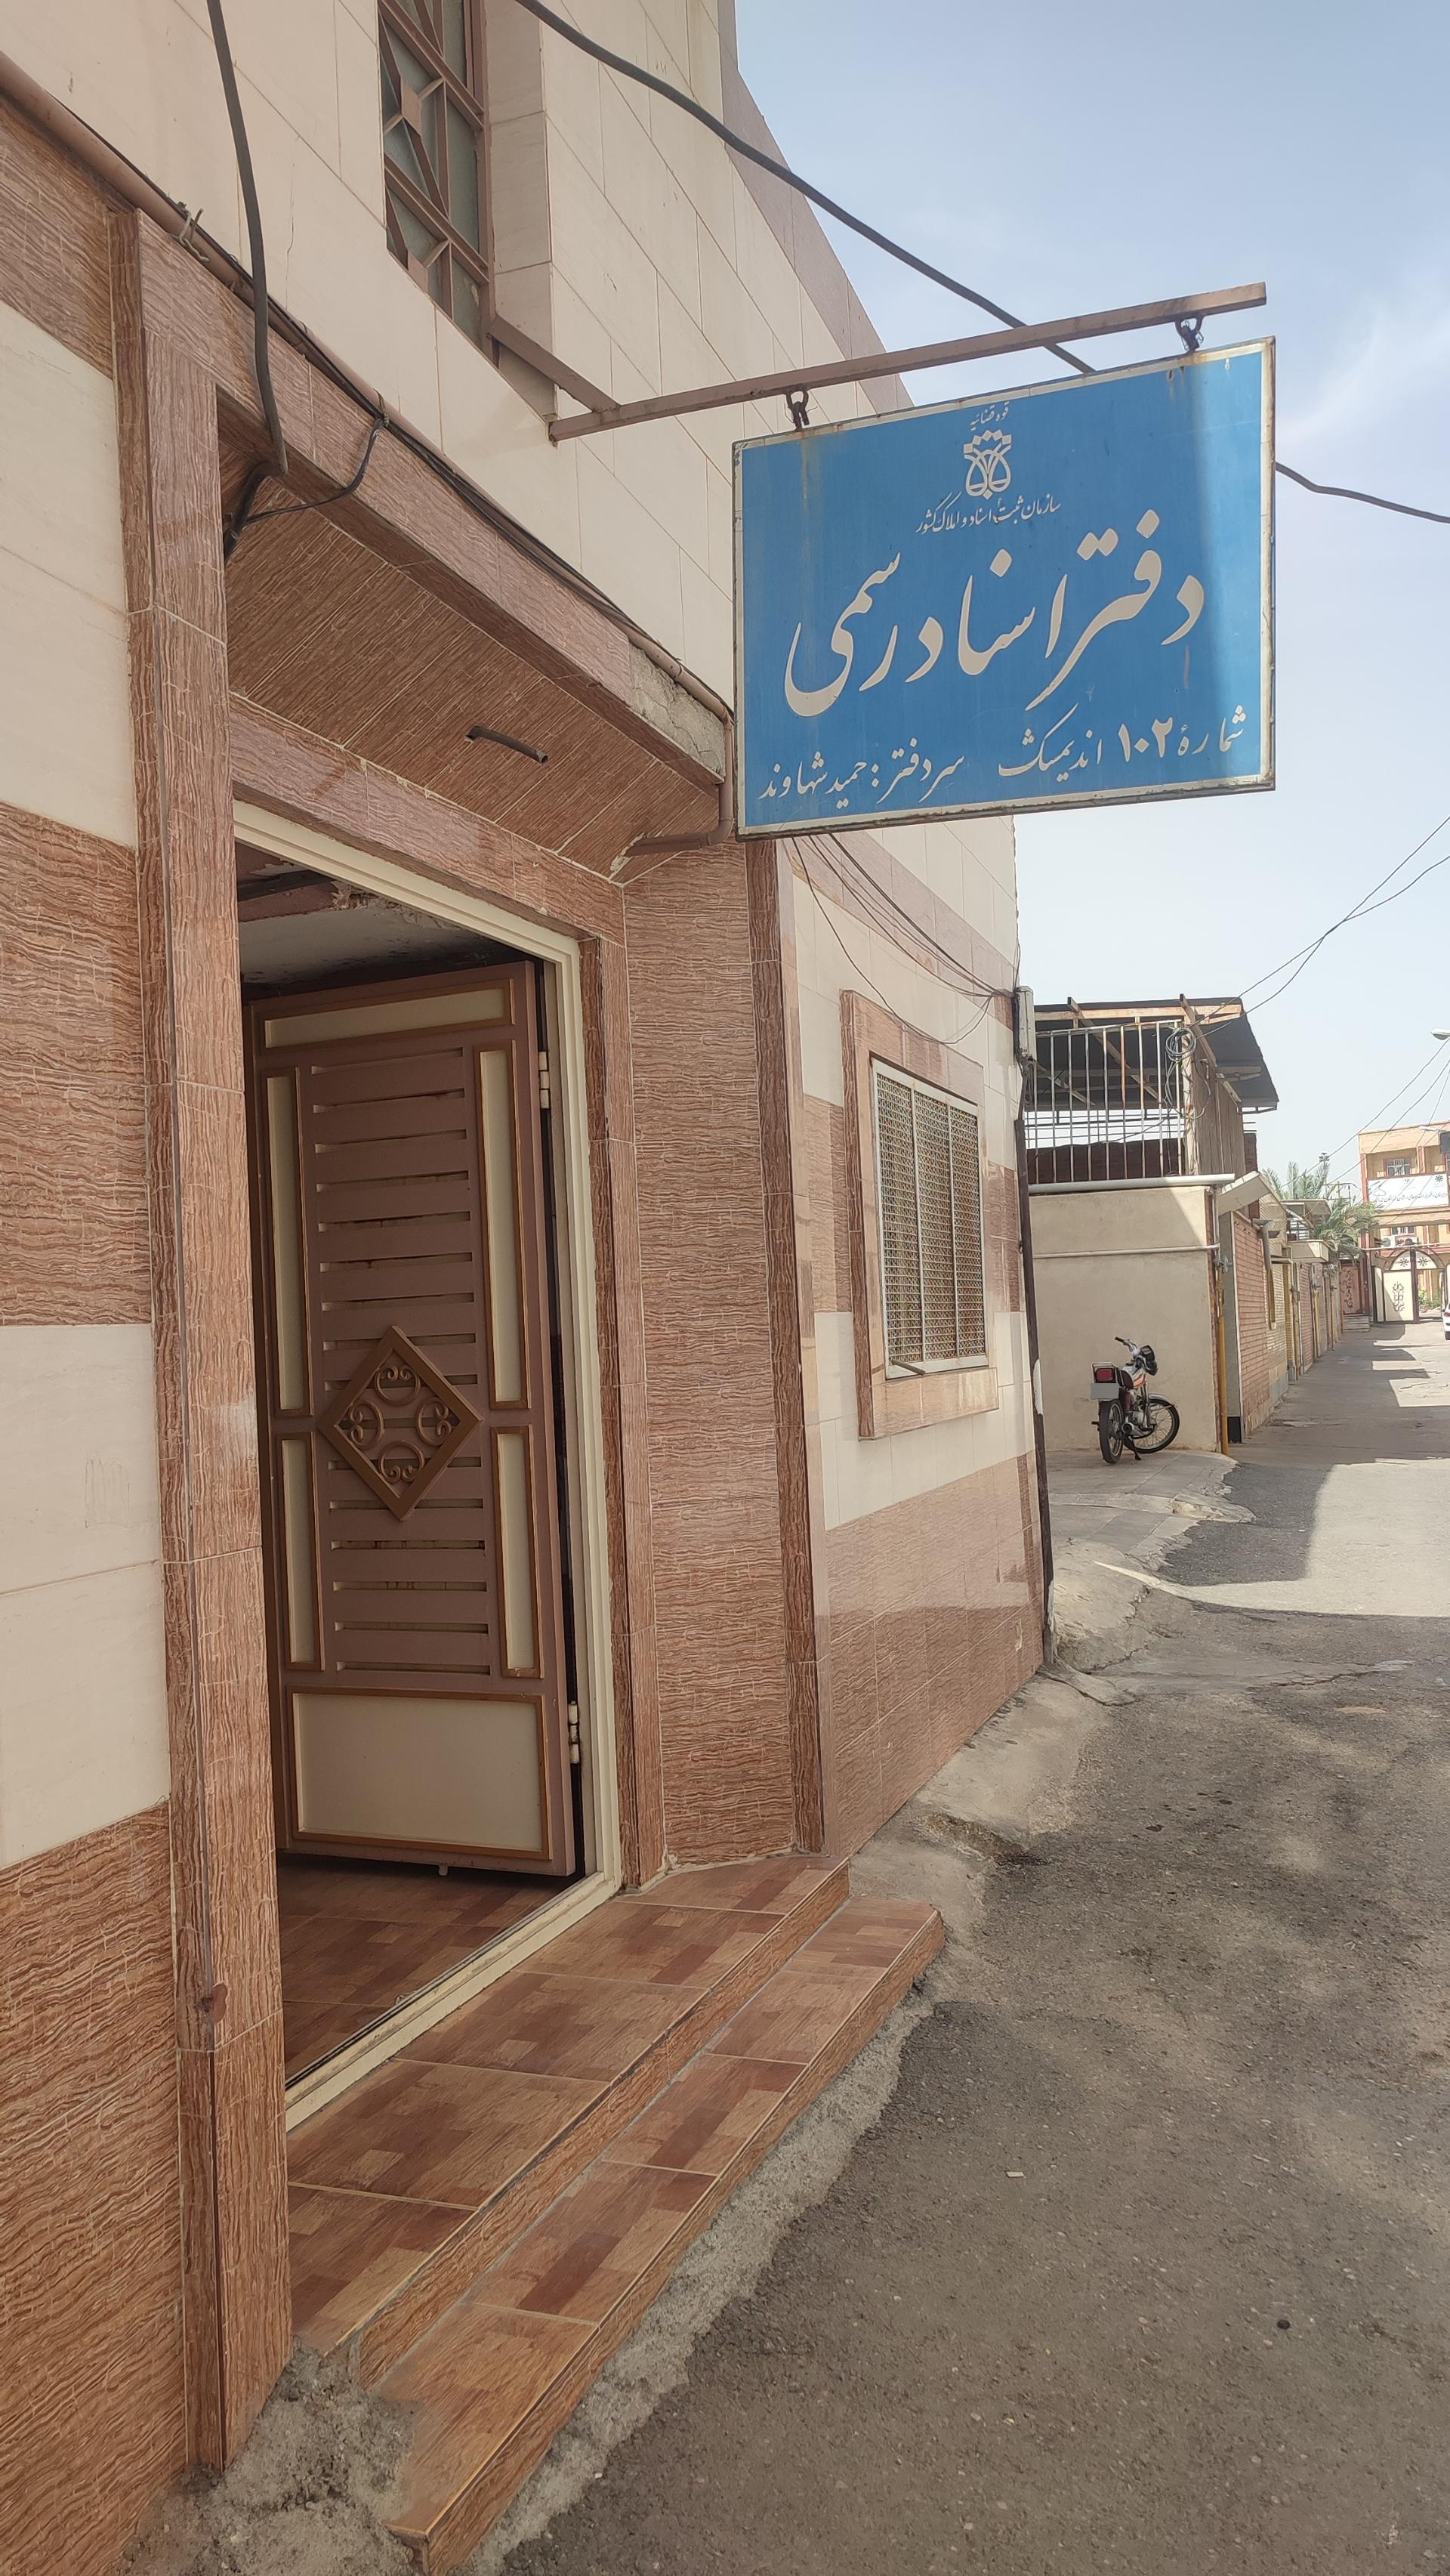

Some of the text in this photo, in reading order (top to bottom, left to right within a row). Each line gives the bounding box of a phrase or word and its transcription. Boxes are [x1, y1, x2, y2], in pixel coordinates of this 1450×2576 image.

[915, 492, 953, 534] کشور
[961, 514, 967, 528] و
[969, 508, 992, 527] اسناد
[1020, 493, 1062, 520] سازمان
[784, 509, 1205, 718] دفتر اسناد رسمی
[998, 703, 1103, 782] اندیمشک
[1118, 717, 1173, 762] ۱۰۲
[825, 761, 868, 809] حمید
